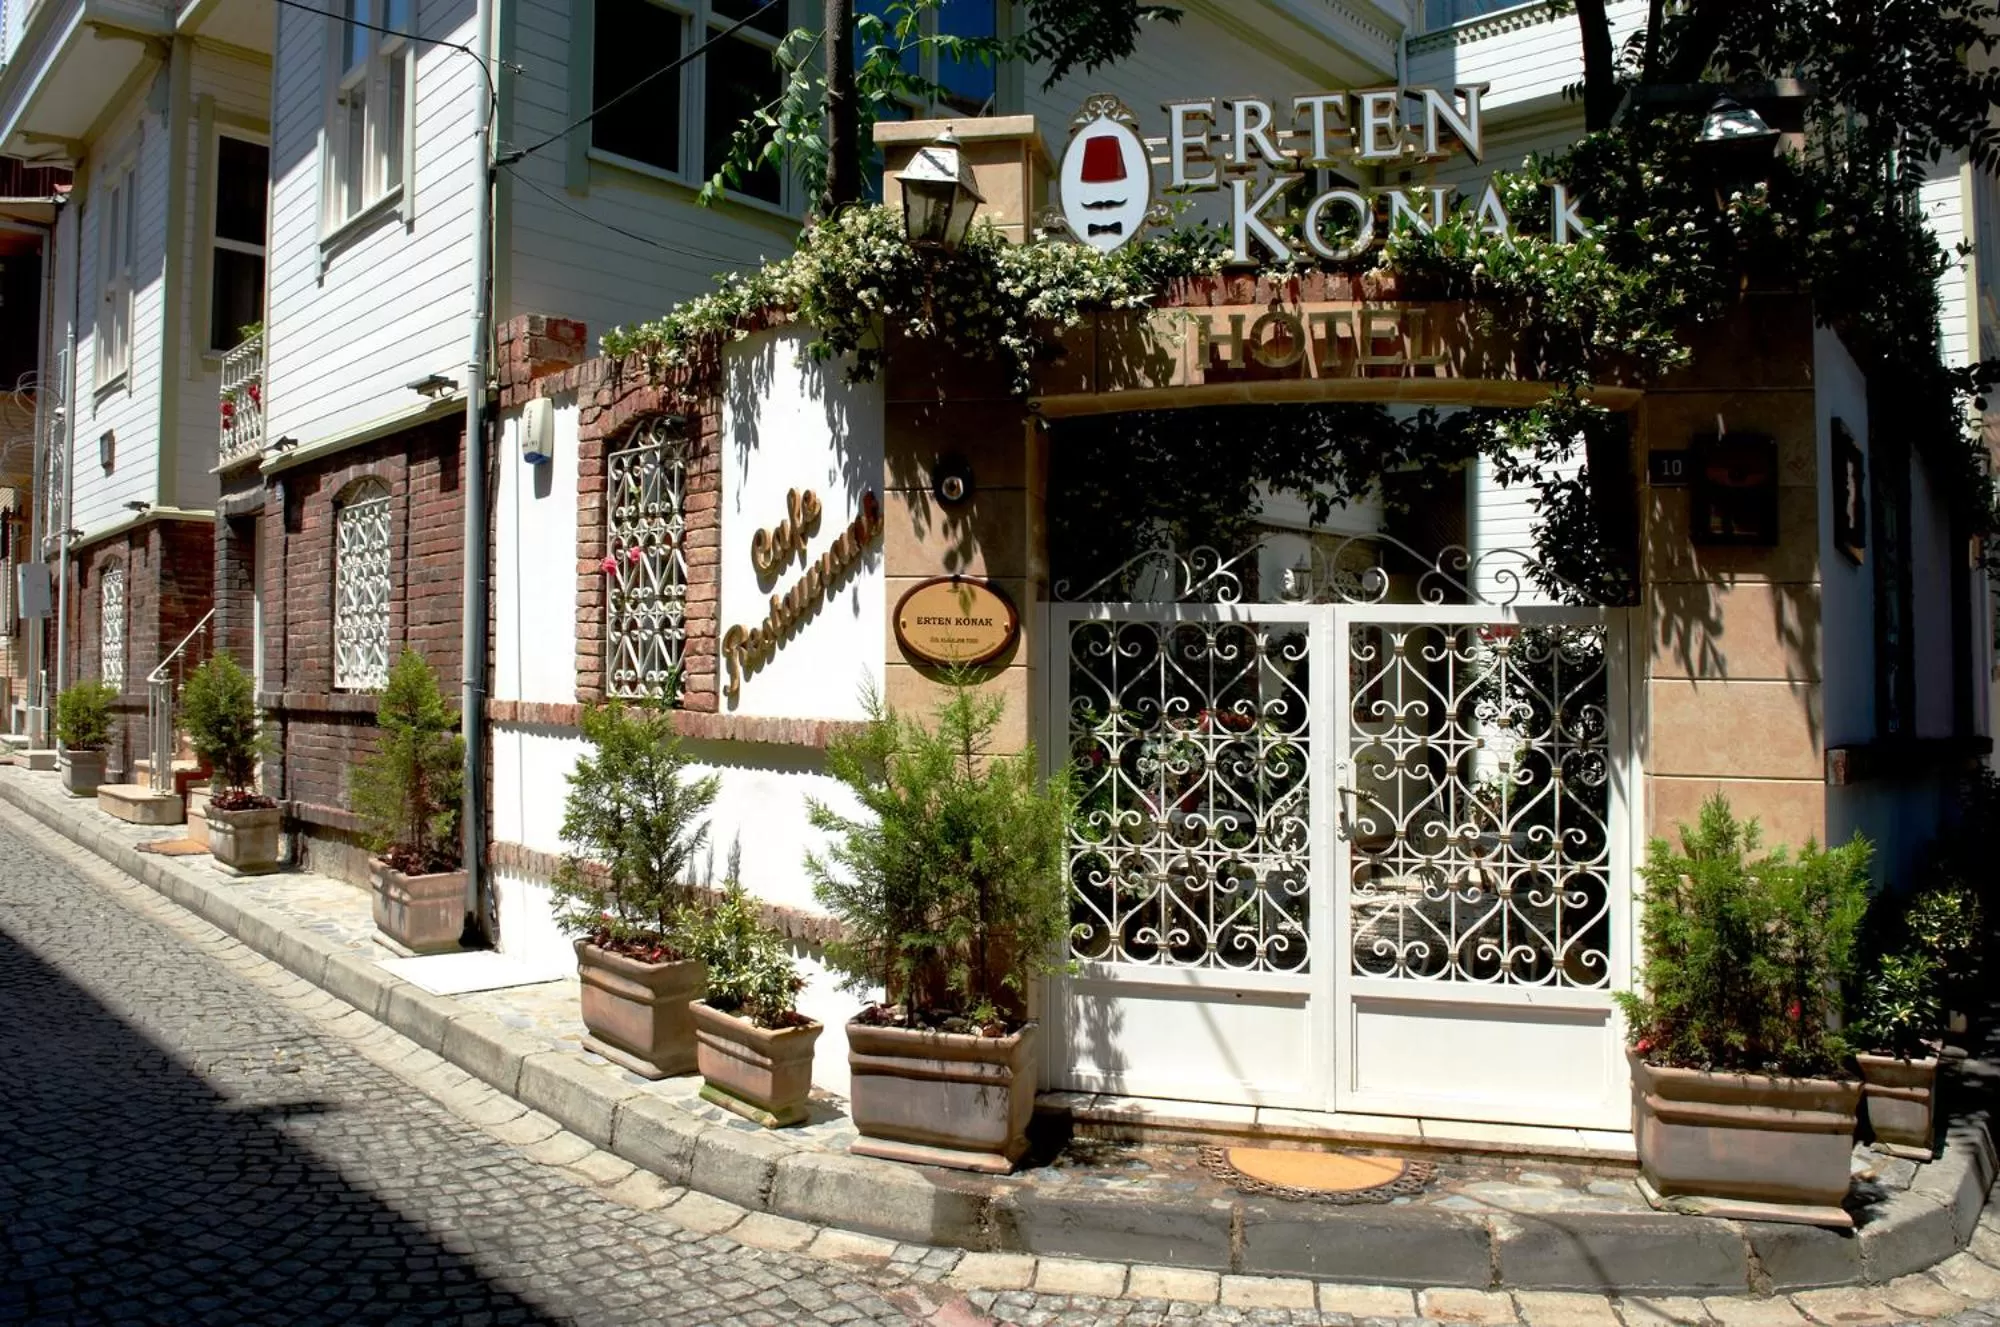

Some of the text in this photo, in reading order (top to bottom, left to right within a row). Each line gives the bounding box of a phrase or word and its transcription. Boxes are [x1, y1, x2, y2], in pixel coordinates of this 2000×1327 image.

[1163, 83, 1489, 188] ERTEN
[1228, 172, 1594, 264] KONAK
[1196, 307, 1451, 370] HOTEL
[1662, 459, 1683, 476] 10
[916, 616, 993, 627] ERTEN KONAK
